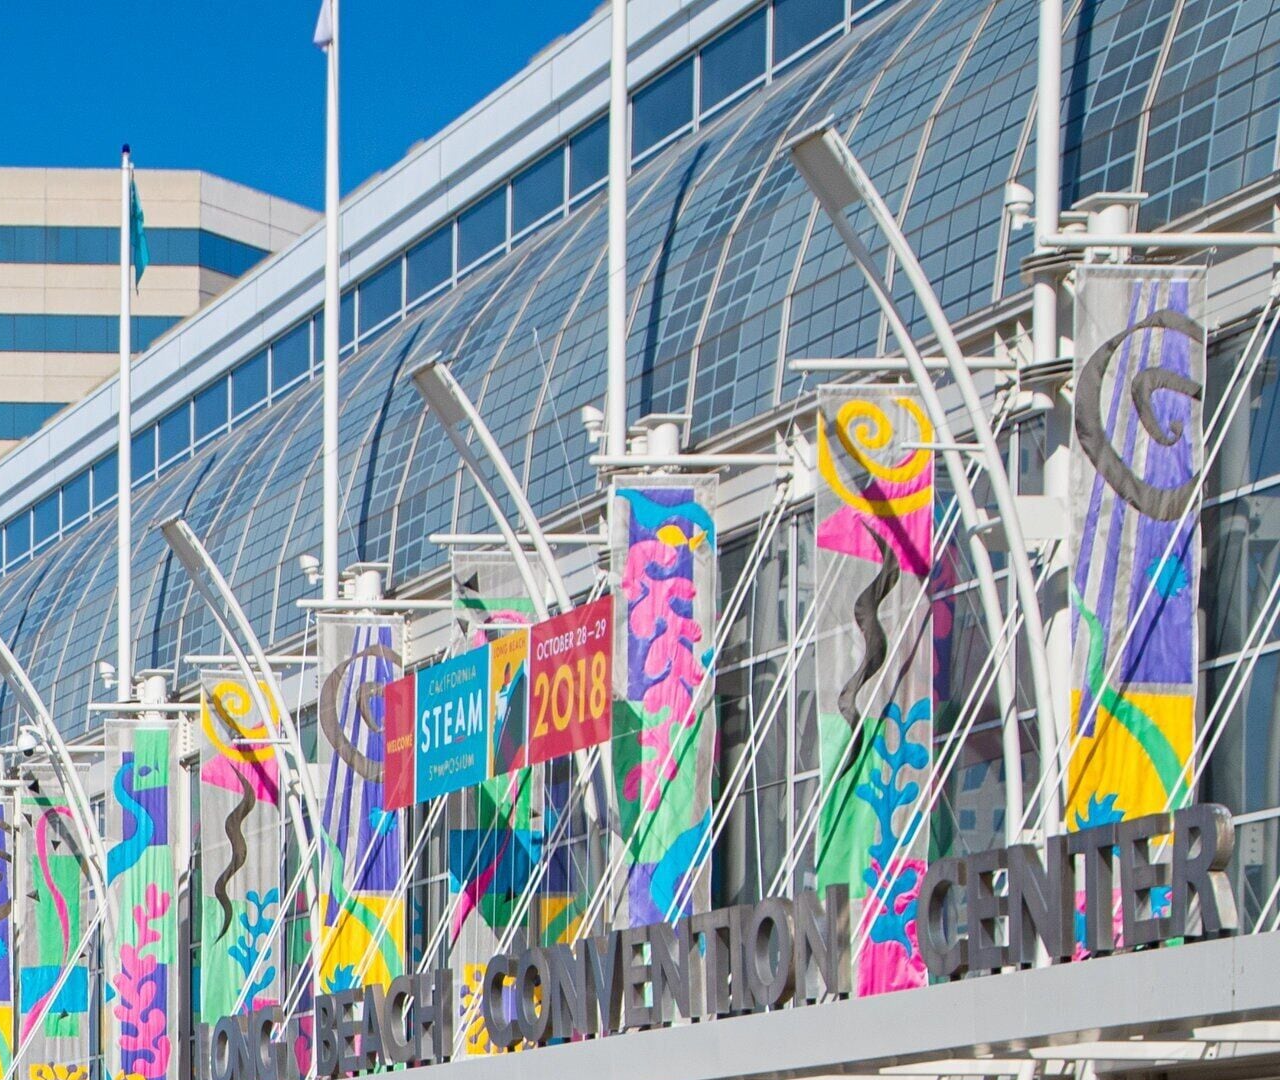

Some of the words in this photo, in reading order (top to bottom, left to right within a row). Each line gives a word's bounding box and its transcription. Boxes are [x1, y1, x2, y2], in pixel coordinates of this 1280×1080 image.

[537, 634, 573, 660] OCTOBER
[428, 665, 476, 696] CALIFORNIA
[533, 650, 607, 738] 2018
[421, 689, 483, 753] STEAM
[386, 734, 413, 754] WELCOME
[429, 753, 475, 781] SYMPOSIUM
[315, 968, 453, 1077] BEACH
[483, 884, 850, 1050] CONVENTION
[918, 803, 1238, 978] CENTER
